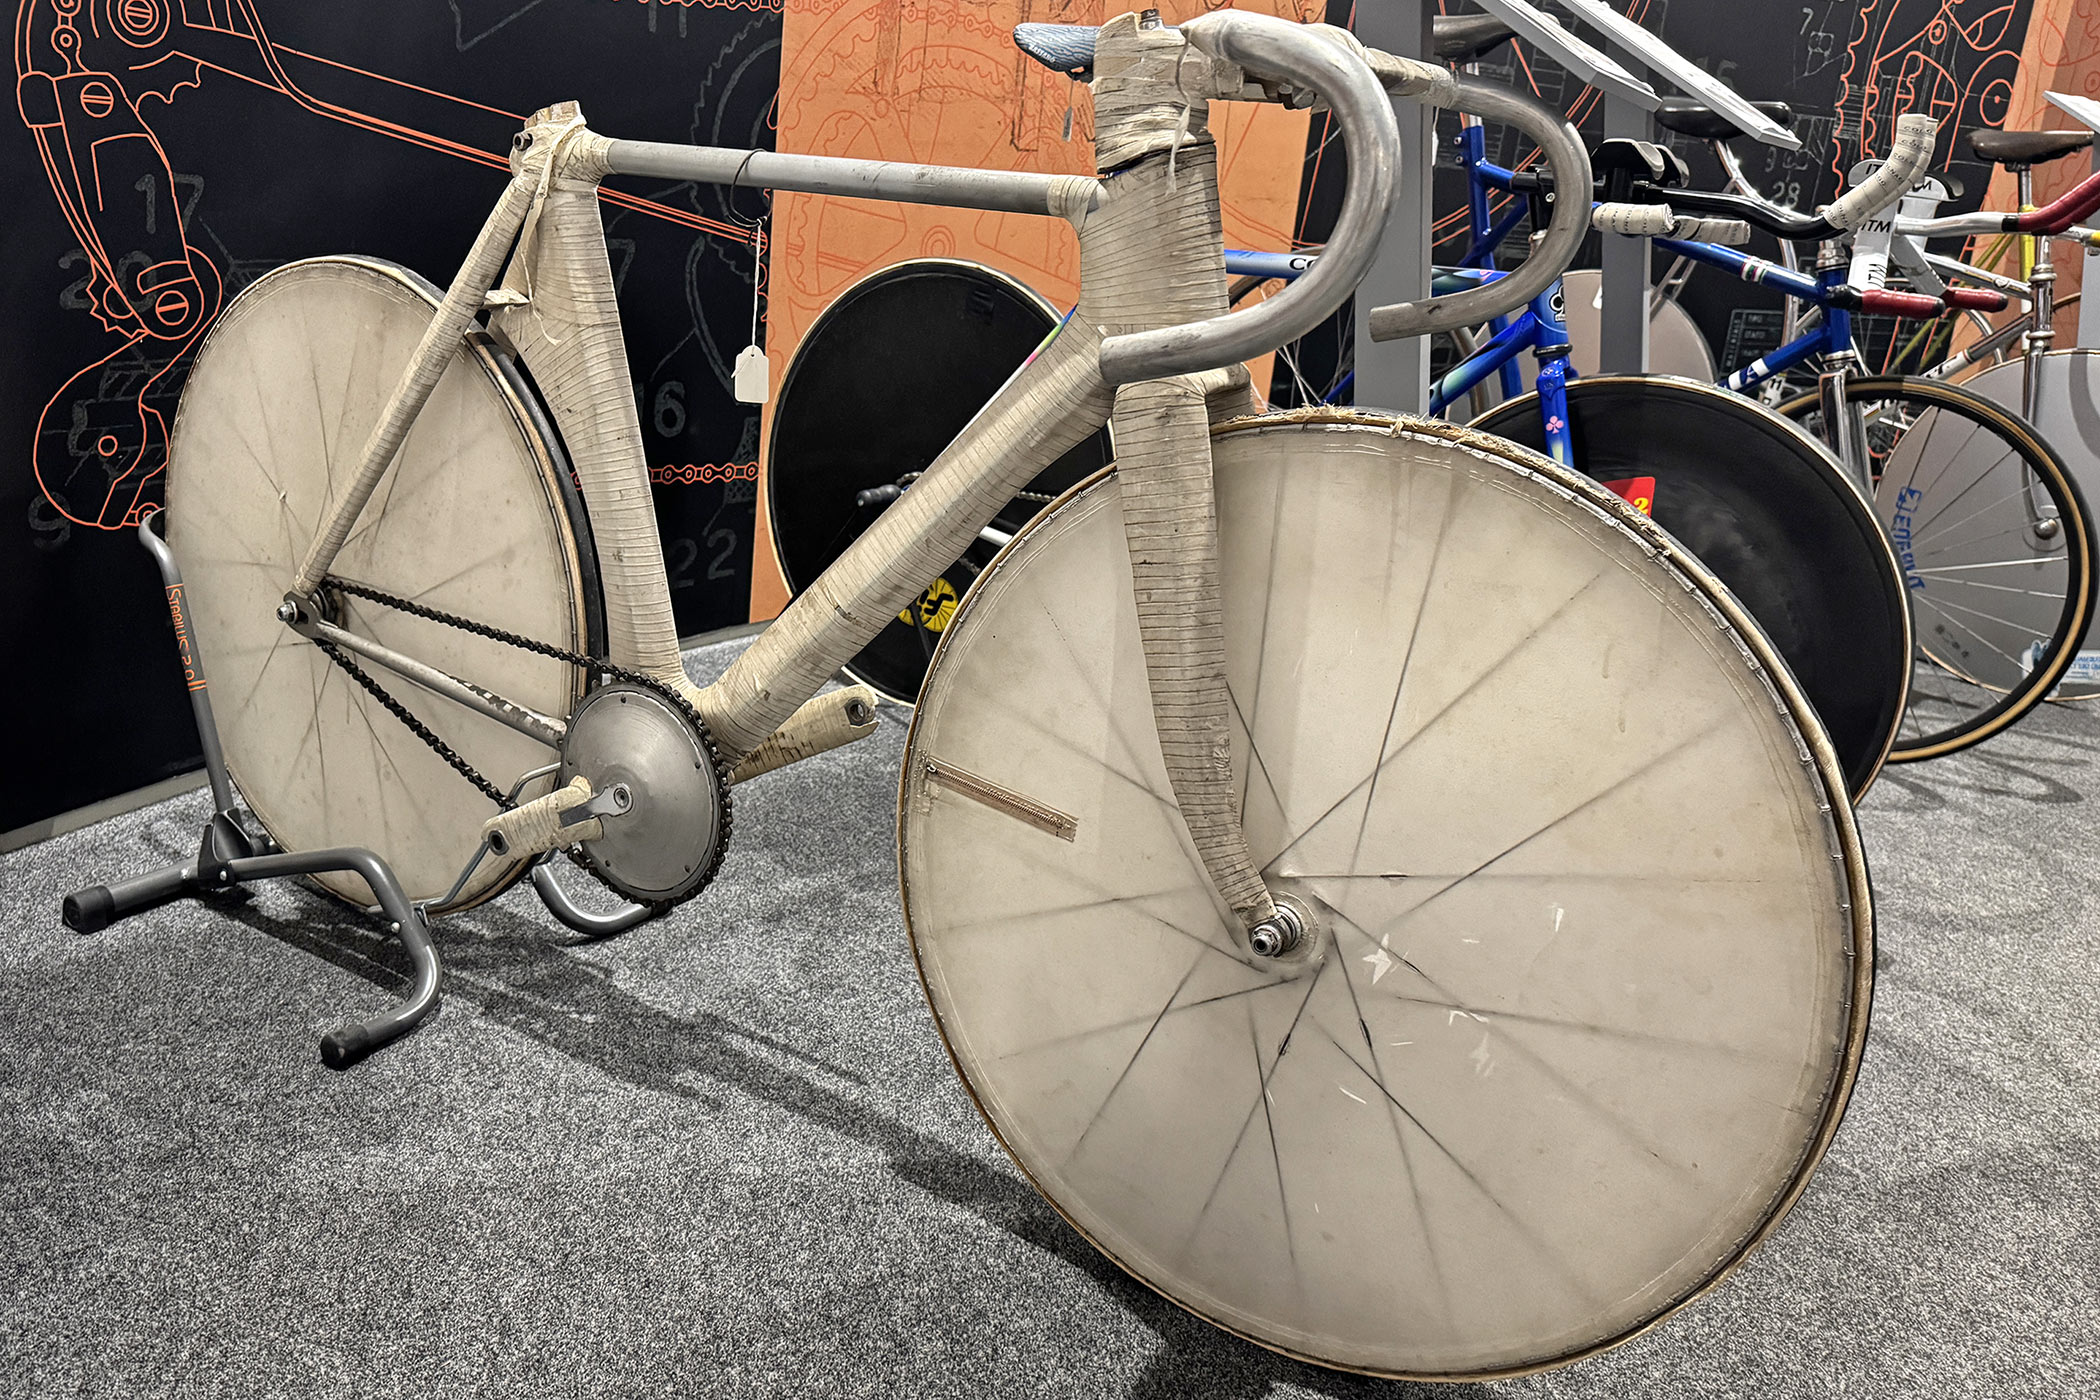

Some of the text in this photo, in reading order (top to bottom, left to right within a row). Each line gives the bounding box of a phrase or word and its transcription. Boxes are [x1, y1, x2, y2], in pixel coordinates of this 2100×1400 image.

[1800, 8, 1814, 34] 7
[135, 174, 204, 234] 17
[1771, 182, 1800, 209] 28
[1861, 219, 1891, 233] ITM
[58, 250, 157, 313] 20
[28, 491, 71, 548] 9
[1633, 496, 1649, 515] 2
[669, 528, 738, 590] 22
